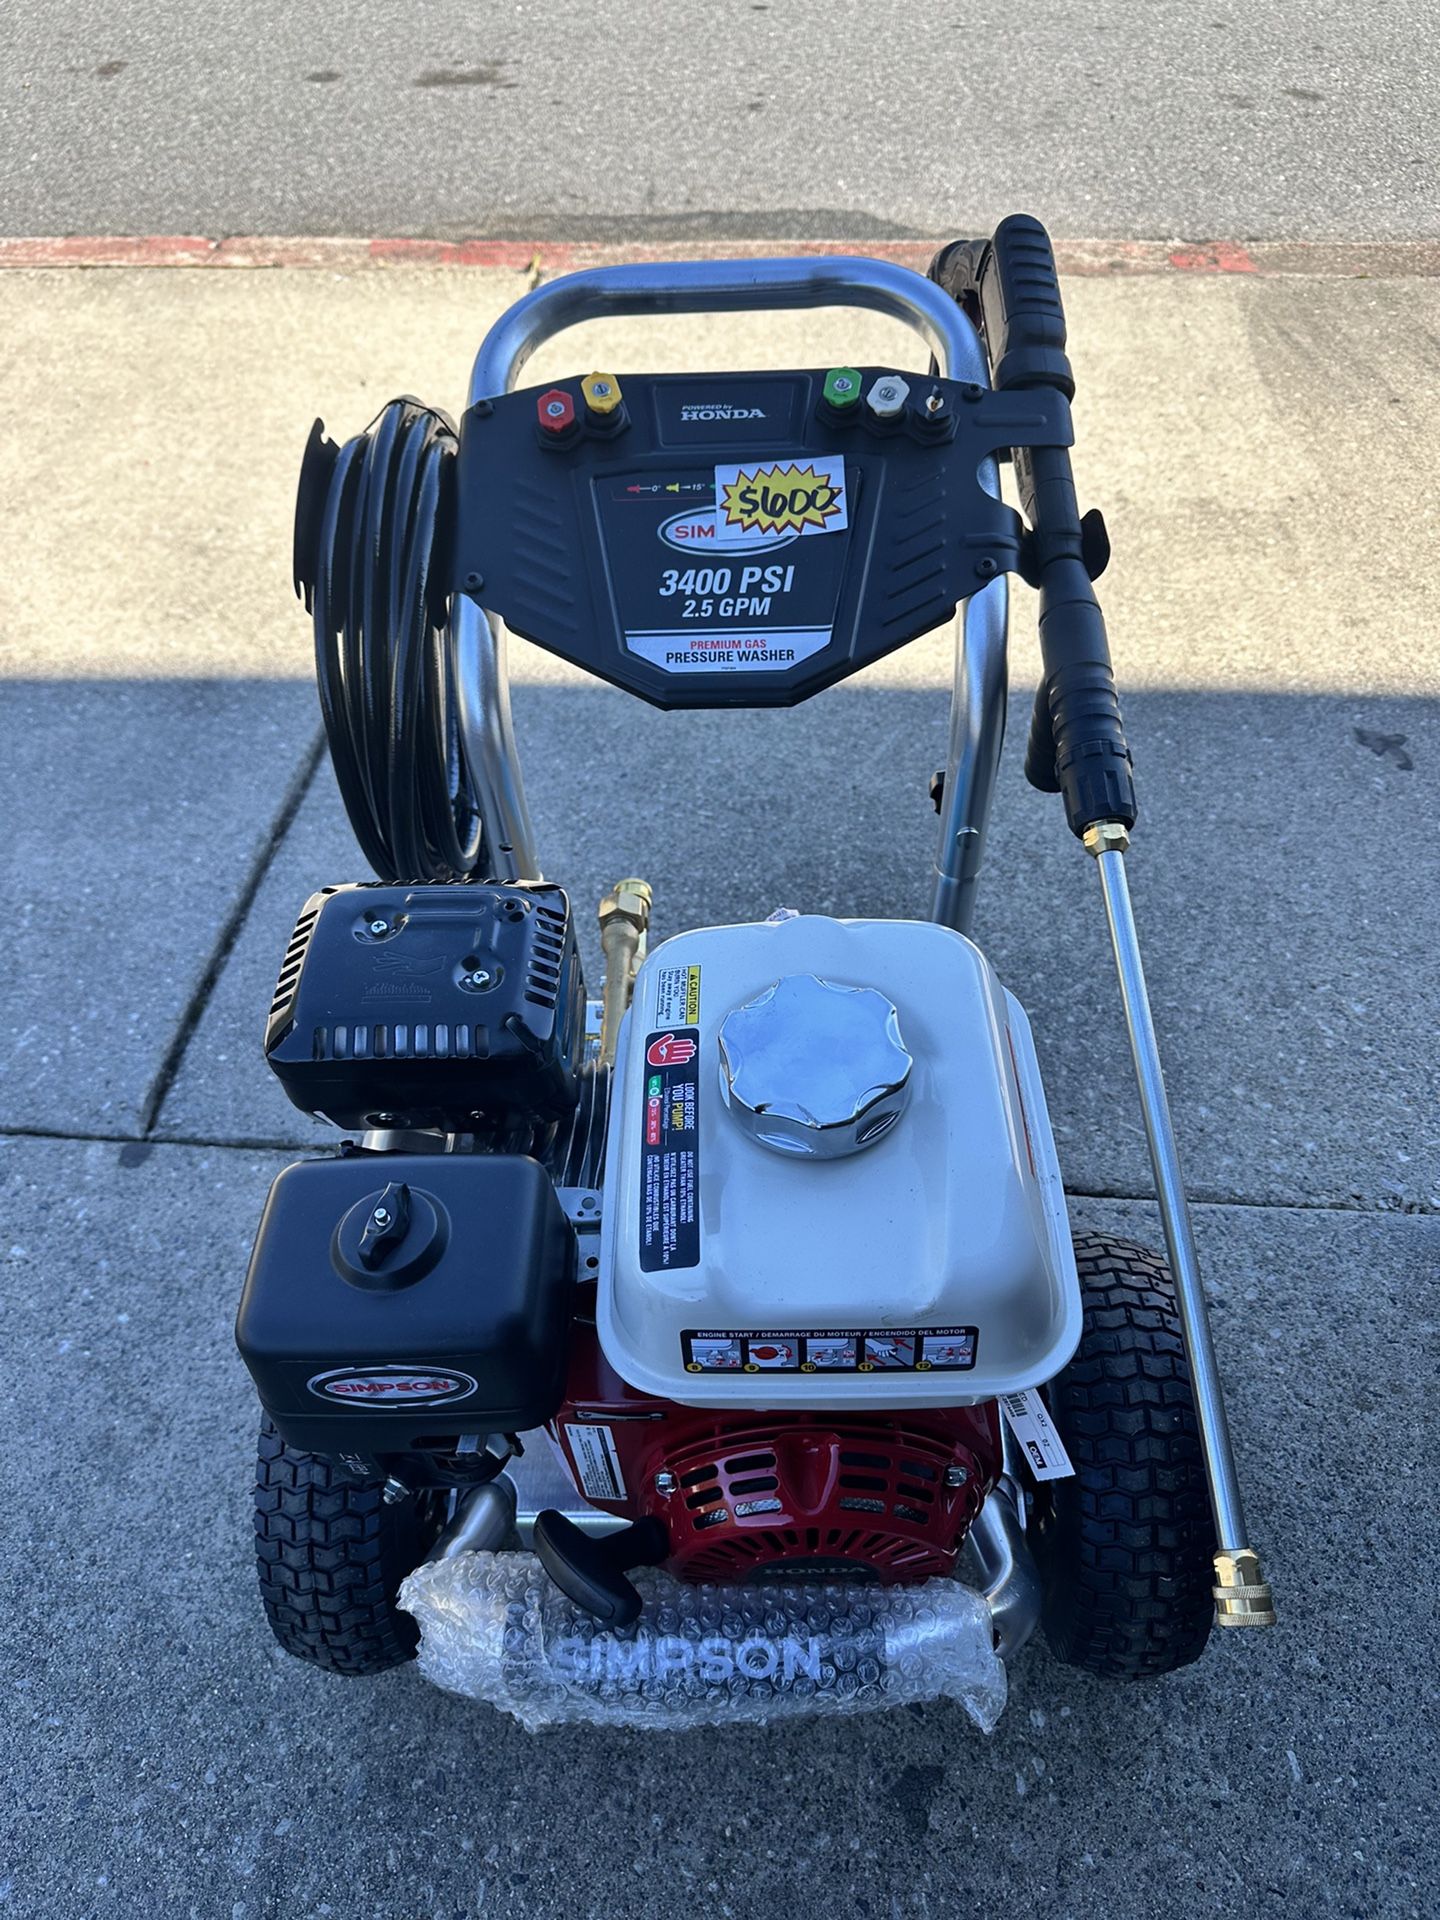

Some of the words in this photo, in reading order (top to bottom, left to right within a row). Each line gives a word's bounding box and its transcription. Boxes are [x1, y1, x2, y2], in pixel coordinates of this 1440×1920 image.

[681, 409, 766, 421] HONDA
[692, 483, 705, 491] 15°
[739, 485, 836, 518] $600
[659, 568, 732, 597] 3400
[739, 565, 795, 594] PSI
[682, 599, 713, 618] 2.5
[719, 597, 771, 617] GPM
[690, 640, 742, 650] PREMIUM
[745, 639, 767, 649] GAS
[666, 651, 734, 664] PRESSURE
[738, 649, 795, 662] WASHER
[689, 981, 698, 1015] CAUTION
[672, 1084, 684, 1101] YOU
[685, 1083, 695, 1101] LOOK
[671, 1102, 684, 1131] PUMP!
[684, 1102, 695, 1130] BEFORE
[333, 1381, 450, 1393] SIMPSON
[1029, 1446, 1043, 1465] OEM
[554, 1636, 821, 1681] SIMPSON
